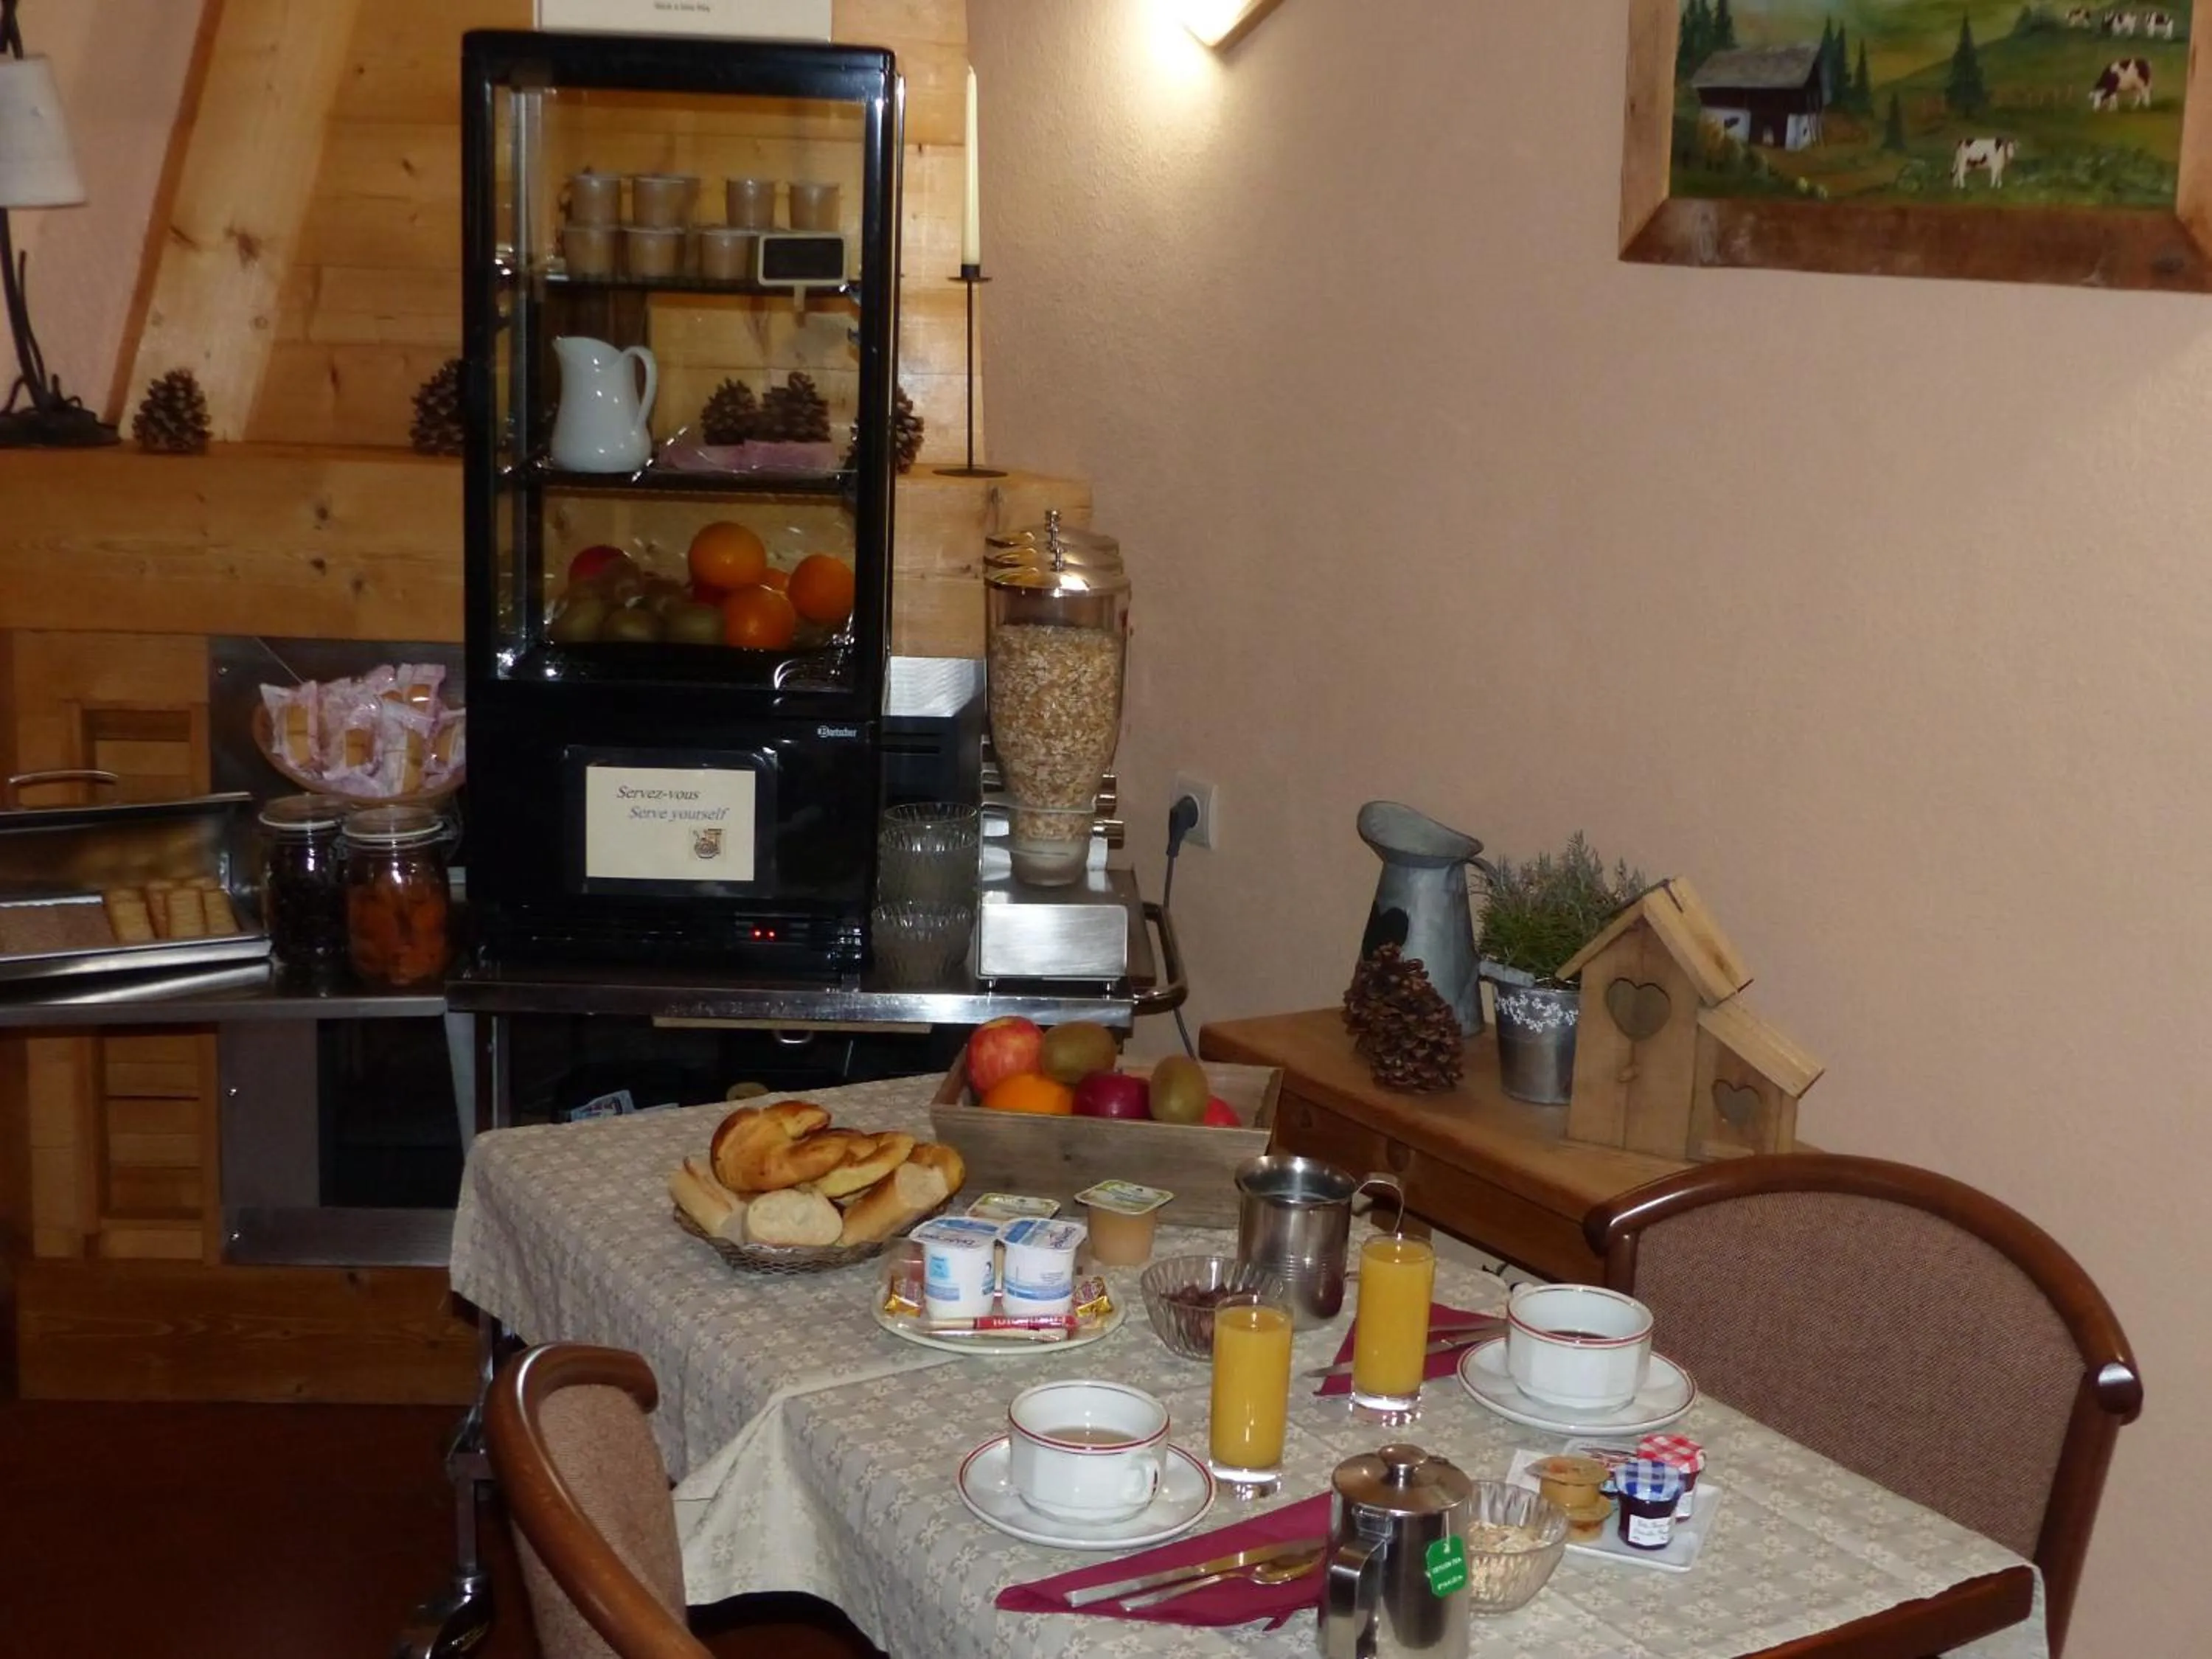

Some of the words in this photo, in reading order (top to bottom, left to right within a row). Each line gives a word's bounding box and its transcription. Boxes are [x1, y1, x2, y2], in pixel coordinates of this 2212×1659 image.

[616, 785, 700, 800] Servez-vous
[629, 805, 667, 820] Serve
[667, 807, 730, 822] yourself
